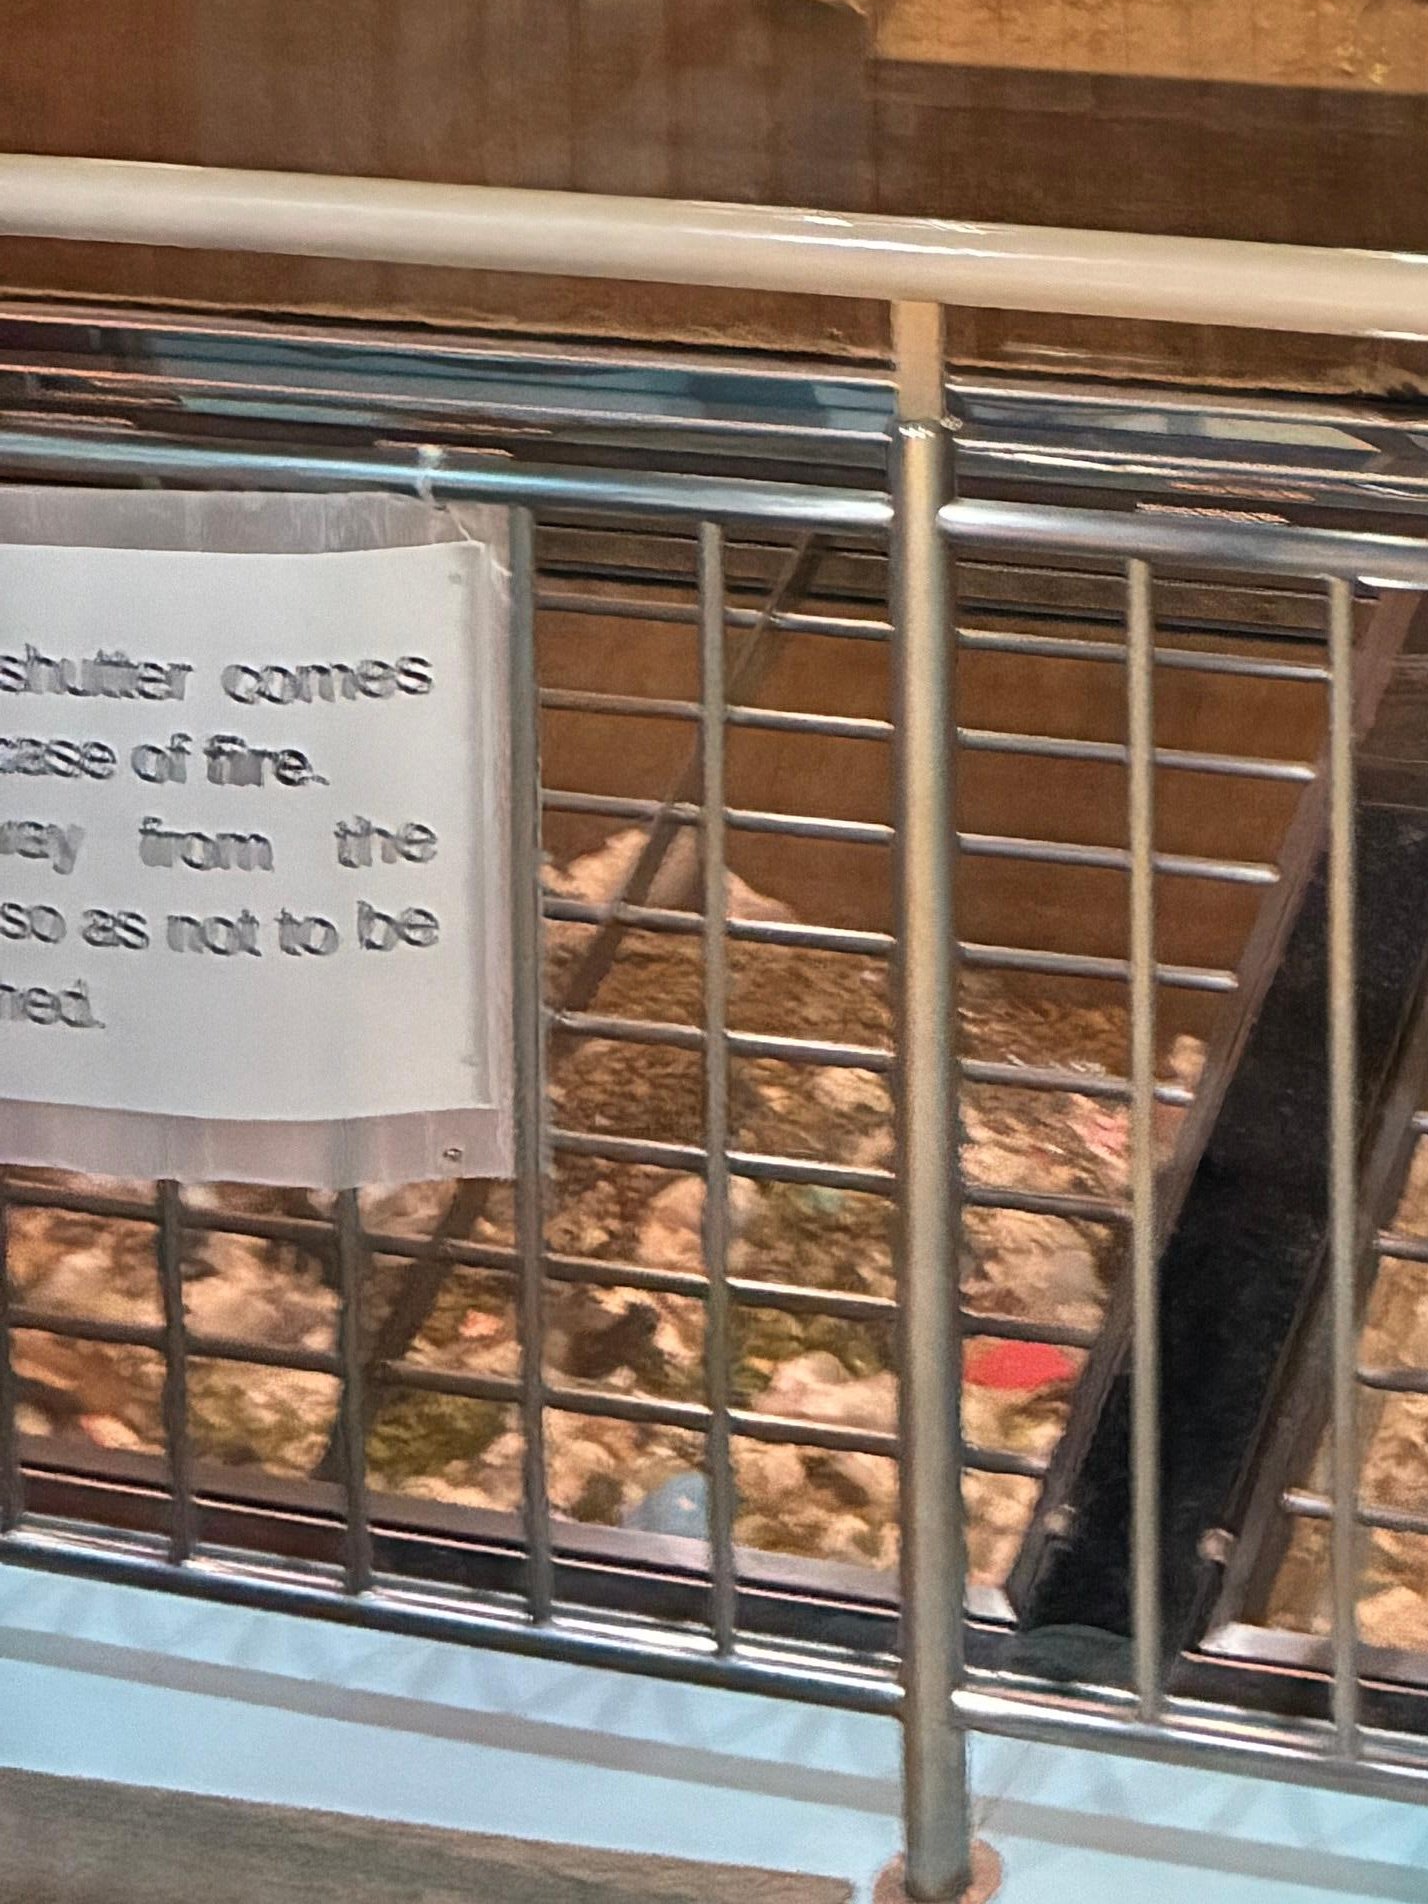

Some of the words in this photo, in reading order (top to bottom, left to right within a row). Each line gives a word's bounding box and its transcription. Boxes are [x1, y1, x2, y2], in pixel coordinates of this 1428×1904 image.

[0, 642, 194, 701] shutter
[220, 656, 434, 705] comes
[131, 733, 192, 784] of
[138, 816, 274, 871] from
[334, 815, 438, 869] the
[0, 902, 67, 944] so
[82, 908, 149, 951] as
[166, 909, 262, 957] not
[274, 907, 340, 956] to
[357, 899, 440, 951] be
